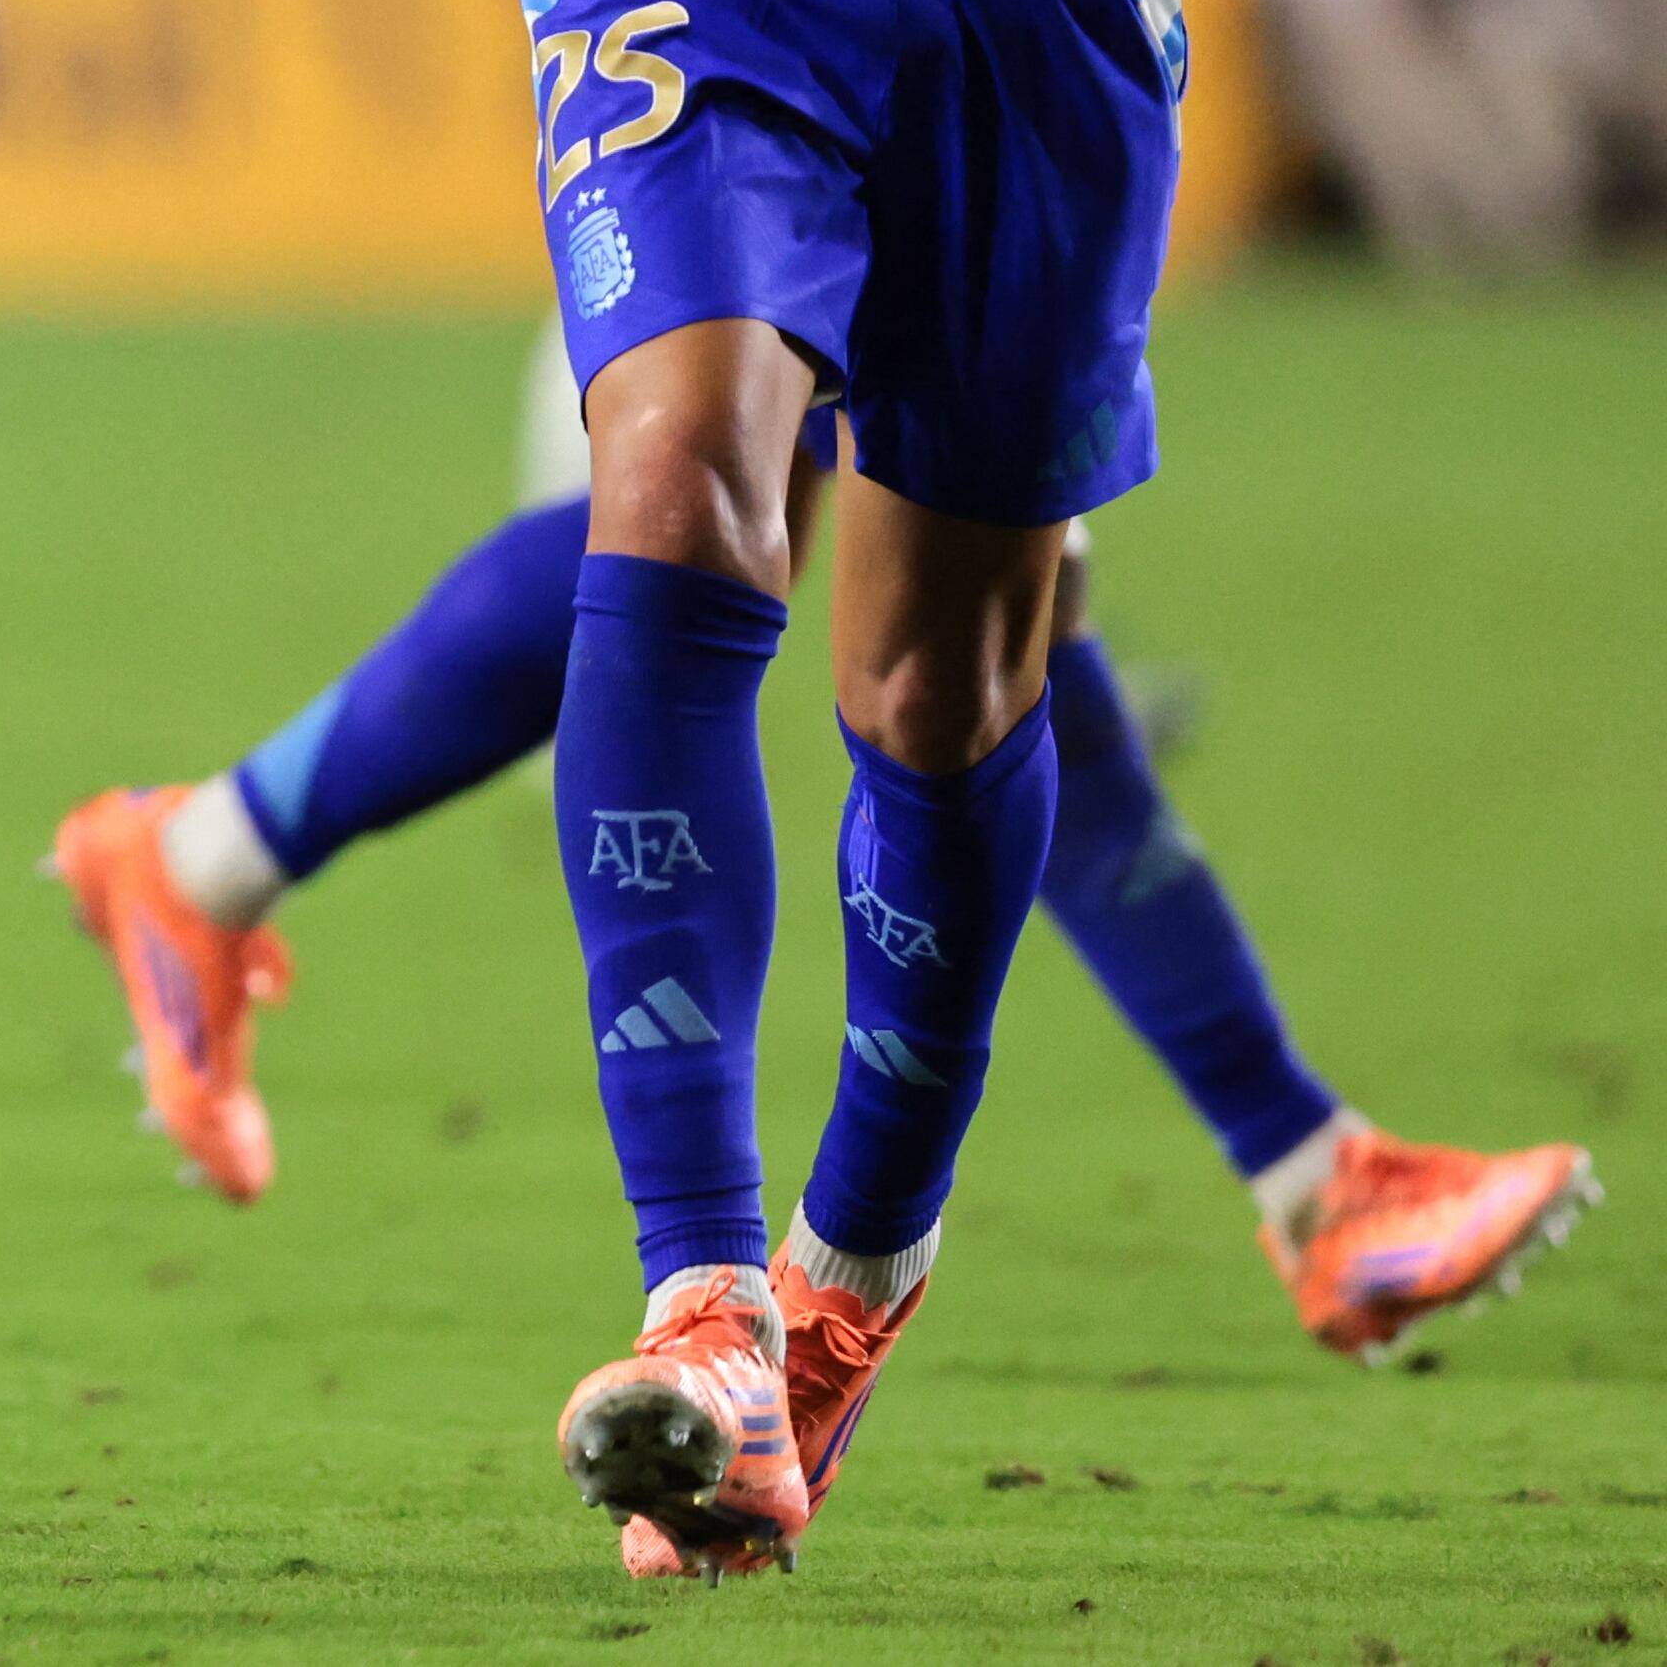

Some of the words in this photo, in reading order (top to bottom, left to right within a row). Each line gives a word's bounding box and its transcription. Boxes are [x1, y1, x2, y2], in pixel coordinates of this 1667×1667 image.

[536, 0, 689, 213] 25
[588, 809, 713, 891] AFA
[844, 872, 952, 969] AFA
